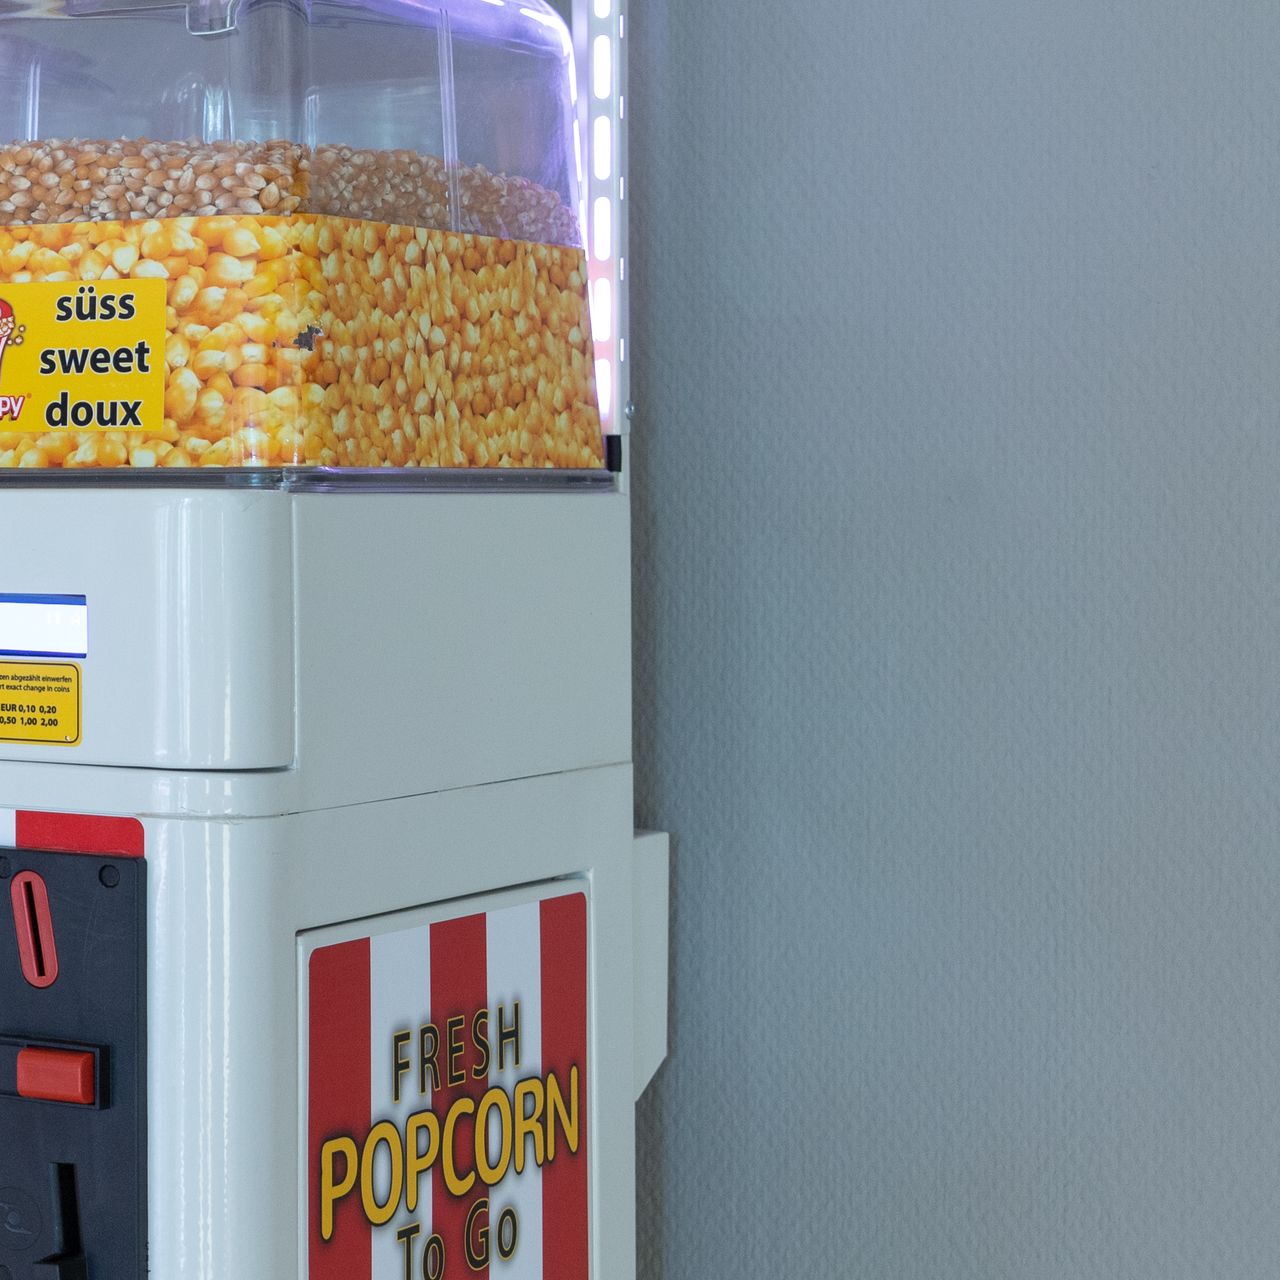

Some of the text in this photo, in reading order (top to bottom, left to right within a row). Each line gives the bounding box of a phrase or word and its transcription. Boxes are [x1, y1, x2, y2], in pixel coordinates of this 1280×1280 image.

[56, 286, 135, 322] süss
[39, 341, 151, 375] sweet
[45, 391, 142, 428] doux
[23, 684, 46, 693] change
[42, 675, 72, 683] einwerfen
[0, 716, 58, 727] 0,50 1,00 2,00
[1, 703, 57, 714] EUR 0,10 0,20
[392, 1001, 521, 1103] FRESH
[320, 1063, 579, 1242] POPCORN
[397, 1197, 518, 1280] To Go
